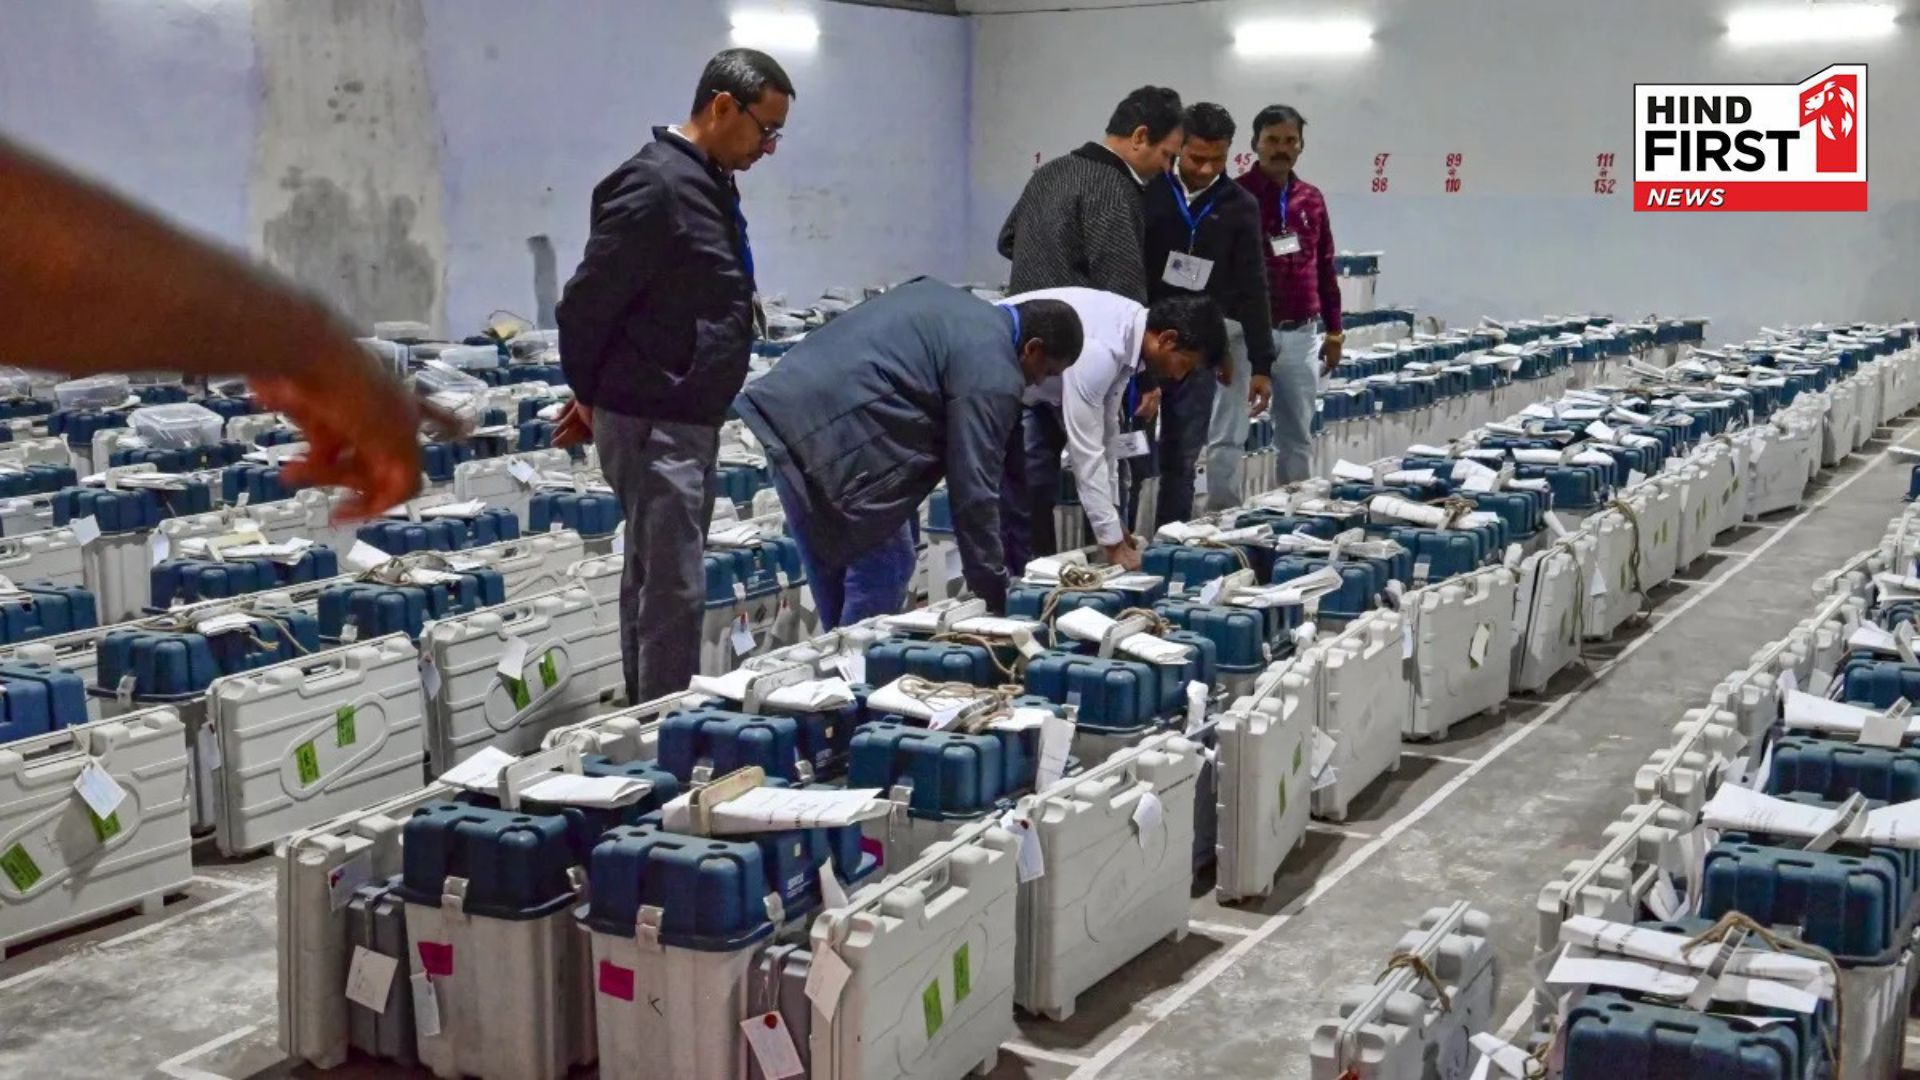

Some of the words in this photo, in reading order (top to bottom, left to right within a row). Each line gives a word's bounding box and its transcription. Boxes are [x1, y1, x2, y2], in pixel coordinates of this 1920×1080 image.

[1234, 153, 1252, 166] 45
[1374, 153, 1390, 167] 67
[1446, 153, 1462, 167] 89
[1597, 153, 1614, 168] 111
[1445, 178, 1462, 193] 110
[1594, 179, 1616, 194] 132
